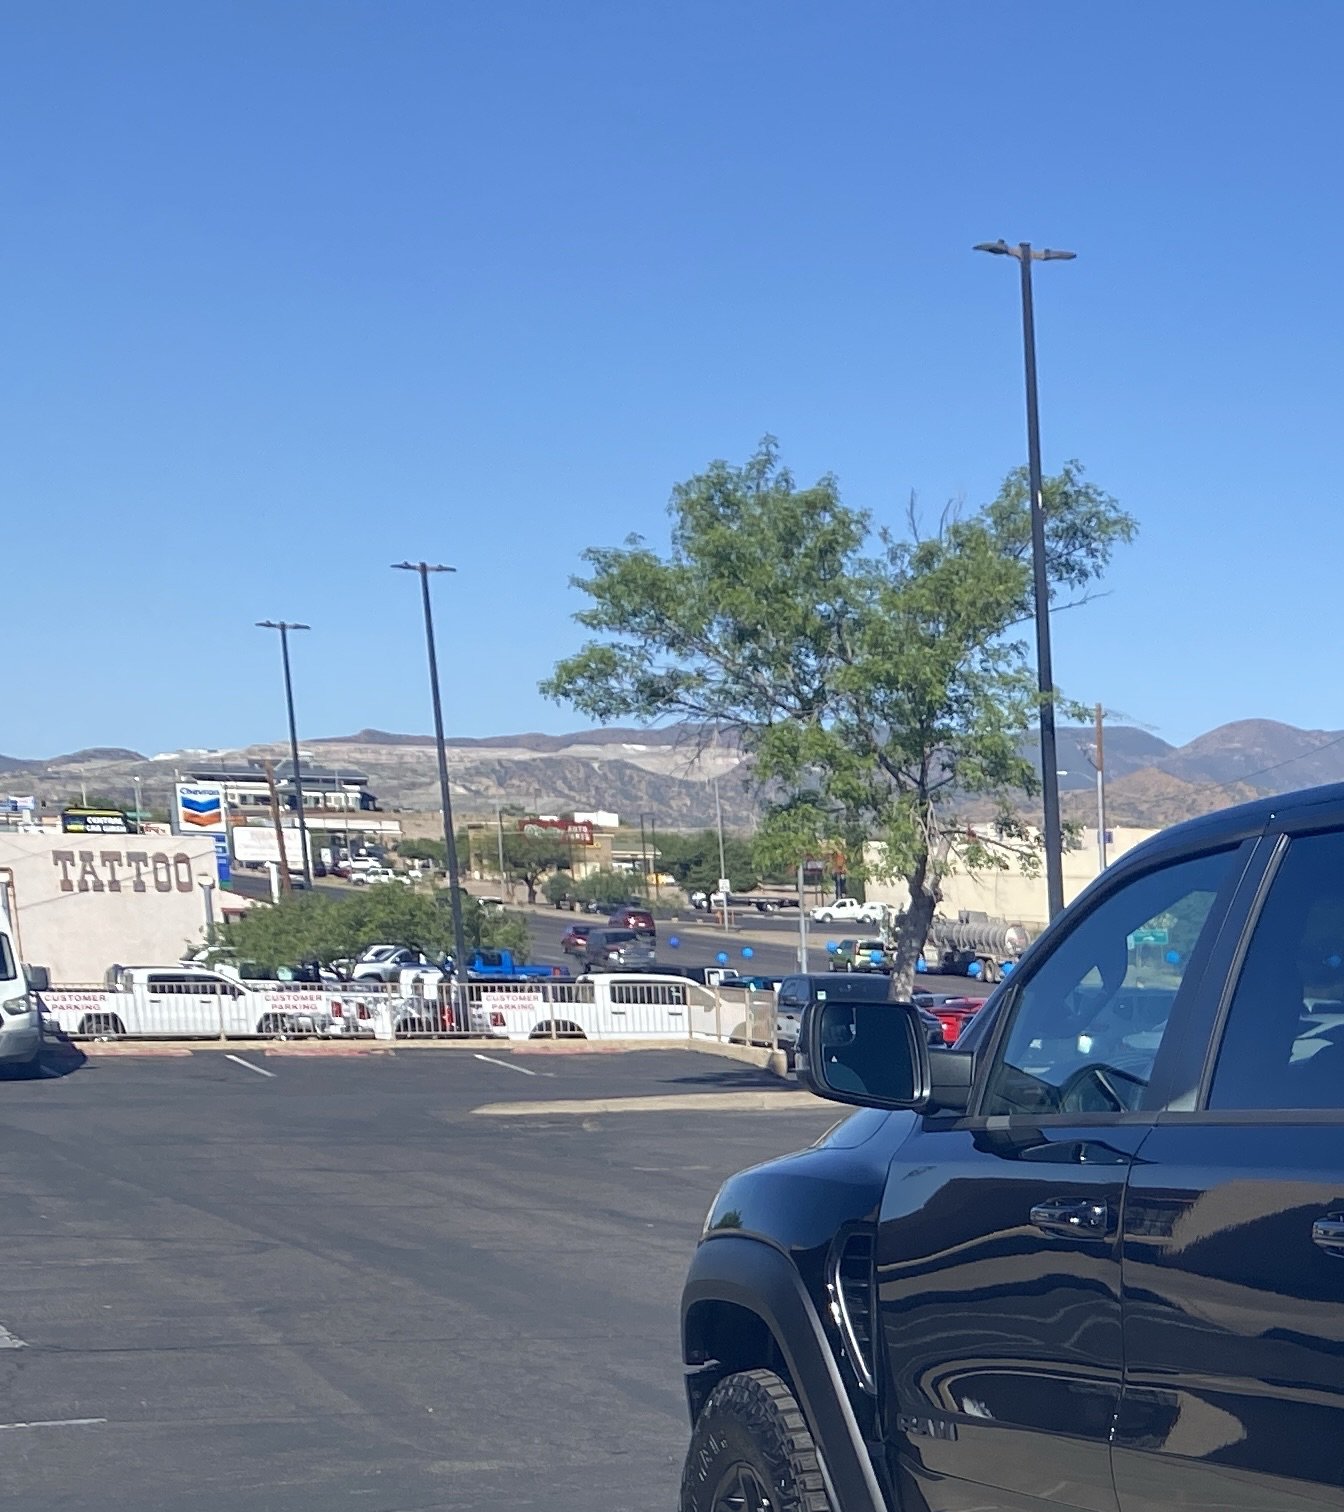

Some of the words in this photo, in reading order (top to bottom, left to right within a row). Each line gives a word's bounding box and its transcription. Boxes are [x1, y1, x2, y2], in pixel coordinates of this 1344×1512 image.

[52, 850, 193, 893] TATTOO
[44, 994, 106, 1002] CUSTOMER
[264, 994, 323, 1002] CUSTOMER
[486, 994, 539, 1002] CUSTOMER
[51, 1003, 101, 1011] PARKING
[271, 1003, 318, 1011] PARKING
[491, 1003, 535, 1011] PARKING
